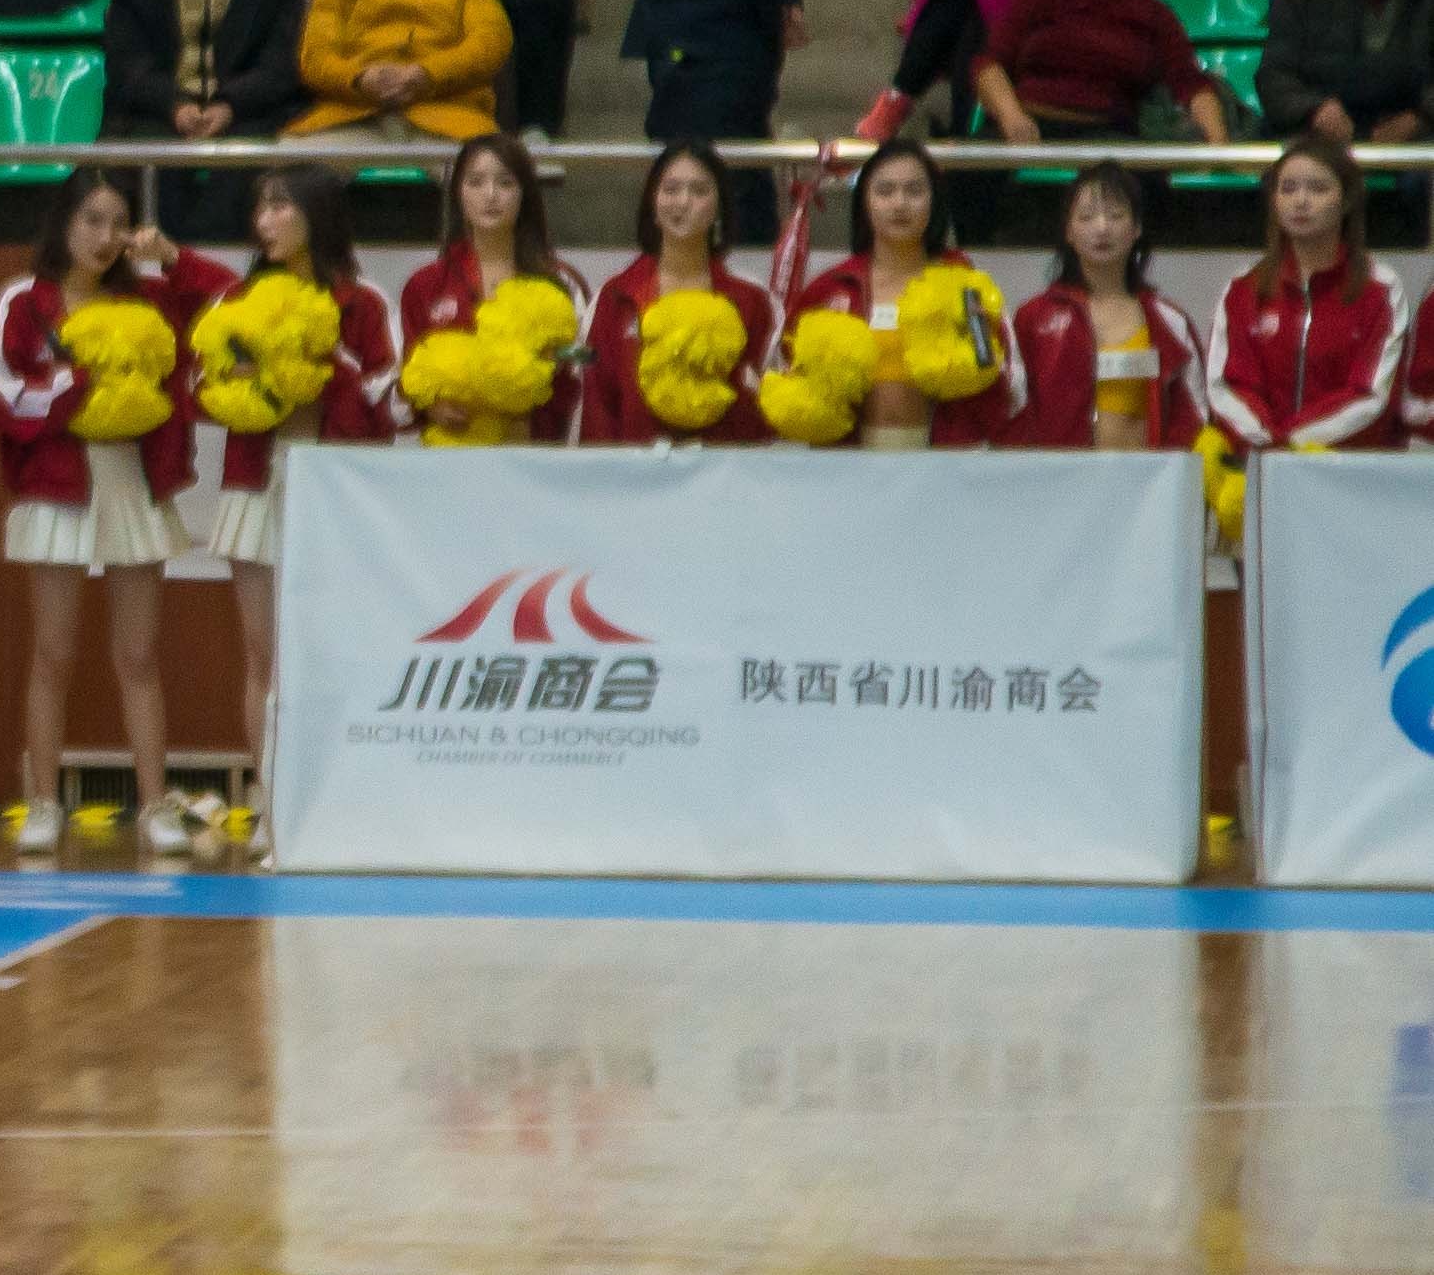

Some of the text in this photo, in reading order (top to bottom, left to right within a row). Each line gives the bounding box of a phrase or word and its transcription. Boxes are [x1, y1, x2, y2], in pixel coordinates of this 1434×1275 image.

[377, 655, 662, 713] 川渝商会
[741, 658, 1102, 713] 陕西省川渝商会
[348, 725, 479, 746] SICHUAN
[518, 726, 701, 747] CHONGQING
